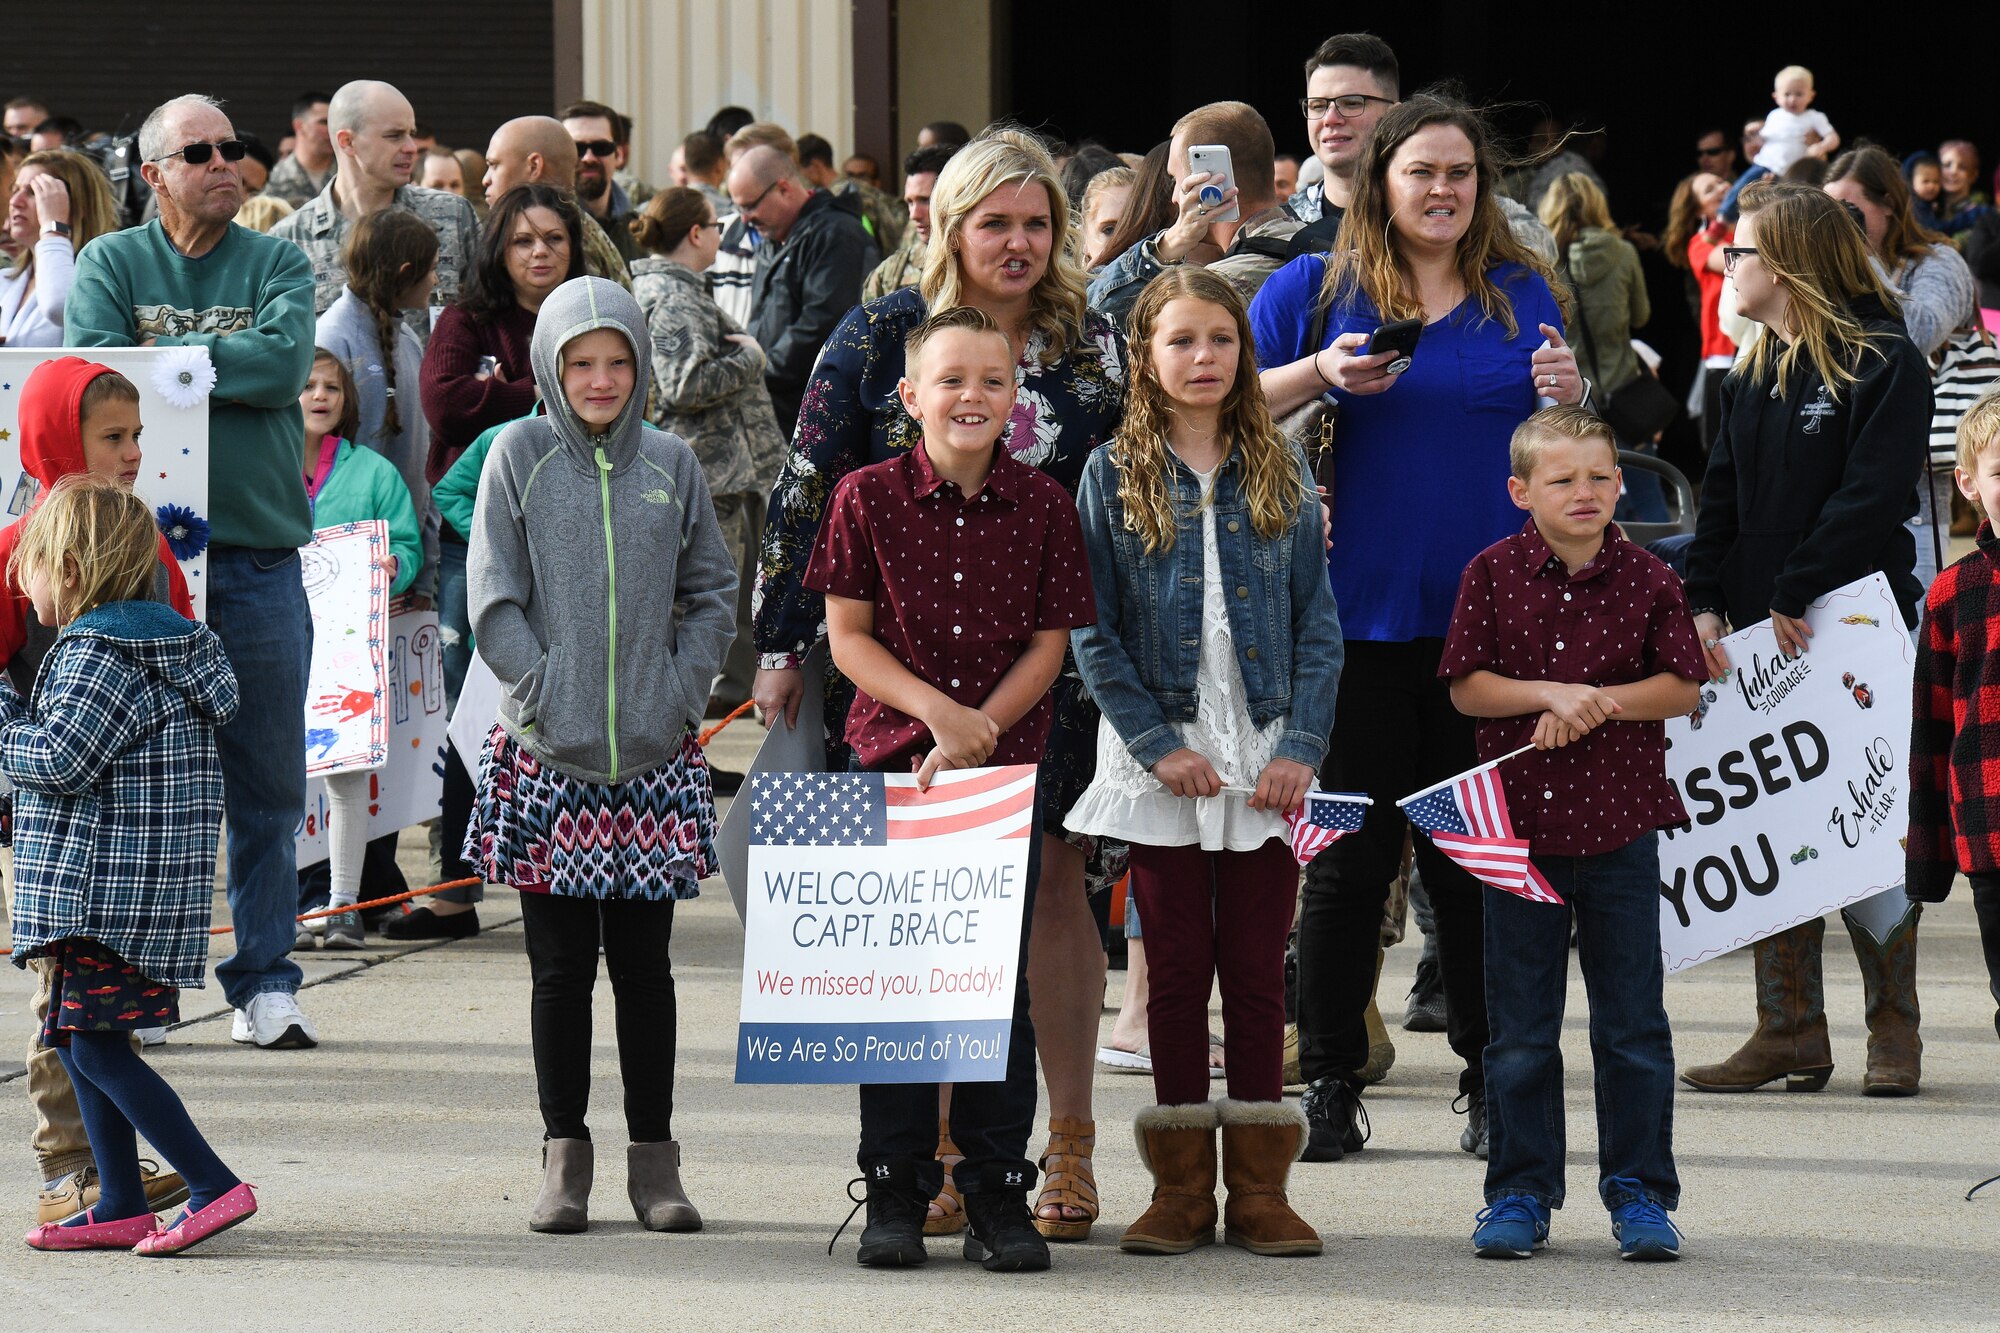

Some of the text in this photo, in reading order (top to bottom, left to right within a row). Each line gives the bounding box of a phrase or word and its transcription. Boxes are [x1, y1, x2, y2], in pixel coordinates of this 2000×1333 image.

[1766, 666, 1806, 708] COURAGE
[1665, 720, 1830, 841] ISSED
[1827, 736, 1894, 849] Exhale
[1870, 793, 1895, 827] FEAR
[764, 864, 1015, 906] WELCOME HOME
[1661, 833, 1780, 928] YOU
[792, 909, 980, 948] CAPT. BRACE
[757, 965, 1004, 1001] We missed you, Daddy!
[747, 1032, 1001, 1062] We Are So Proud of You!
